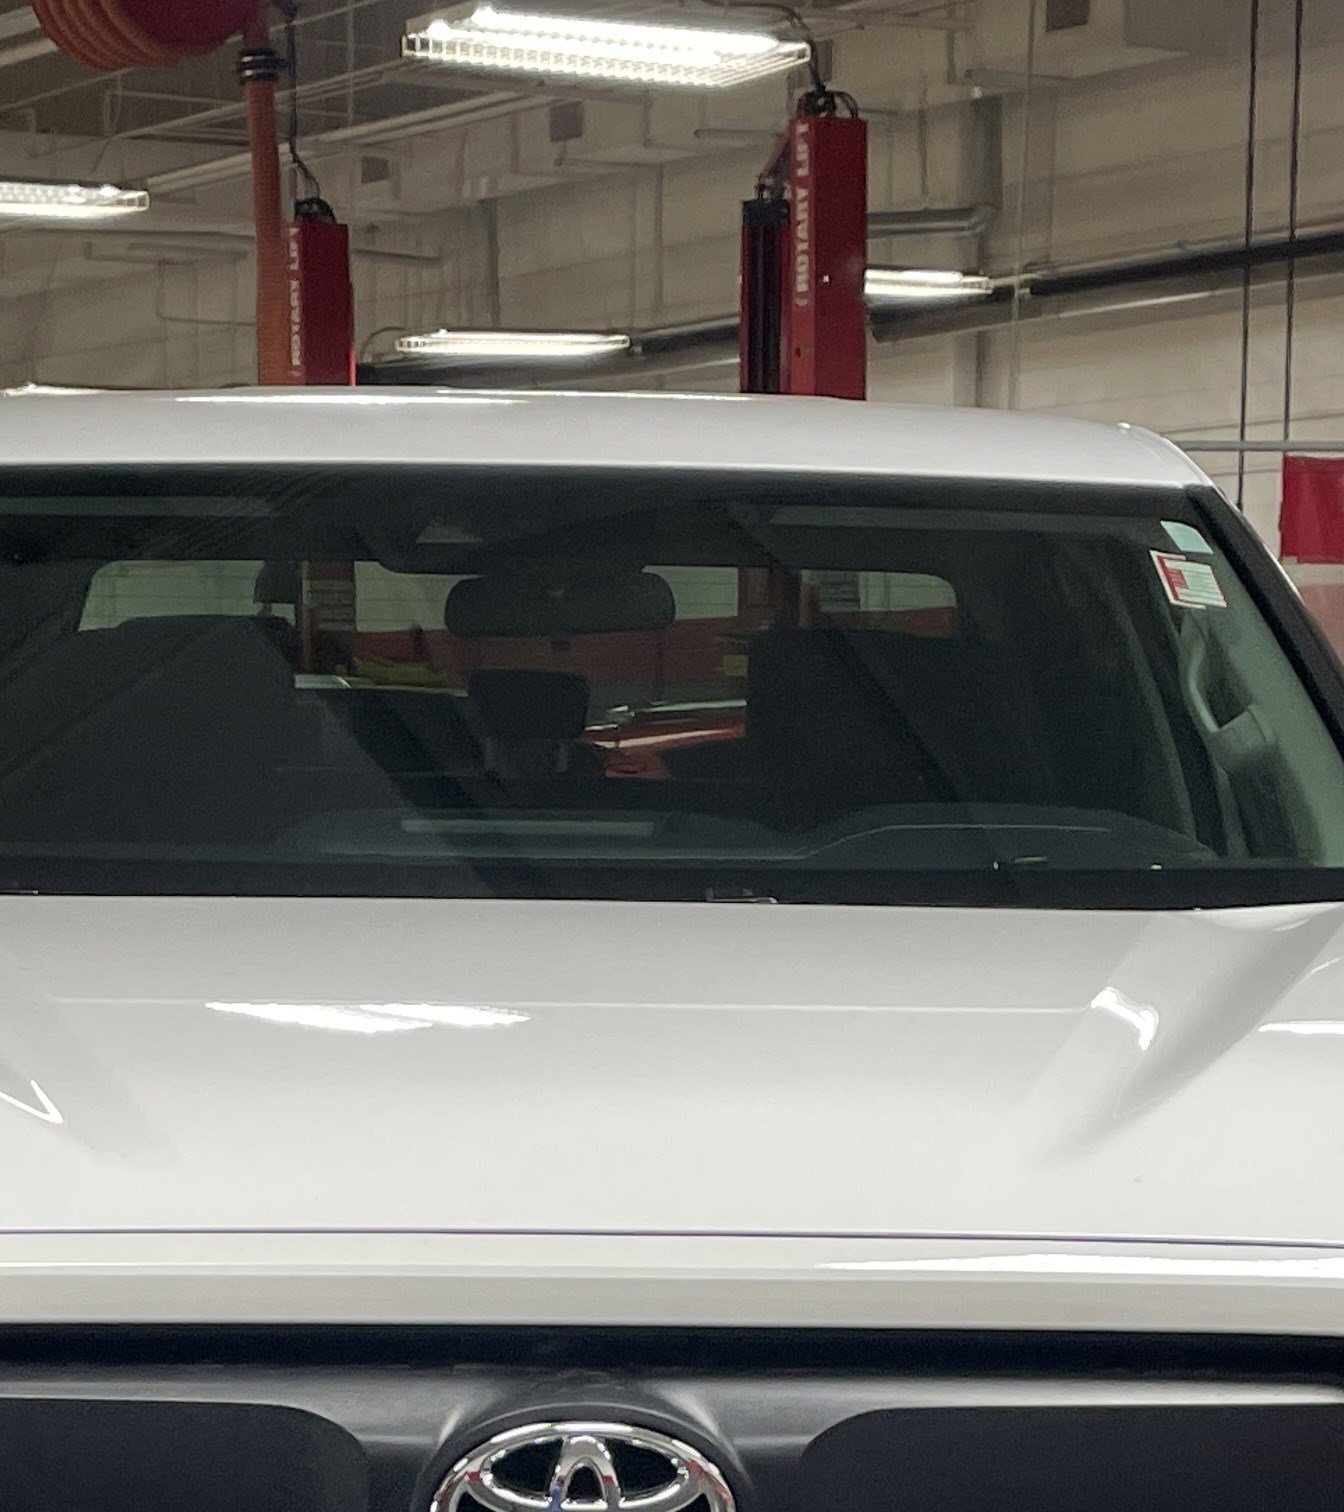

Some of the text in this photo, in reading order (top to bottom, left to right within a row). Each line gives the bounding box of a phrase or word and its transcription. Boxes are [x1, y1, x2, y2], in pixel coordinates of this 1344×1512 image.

[795, 123, 809, 292] ROTARY LIFT
[289, 279, 301, 366] ROTARY
